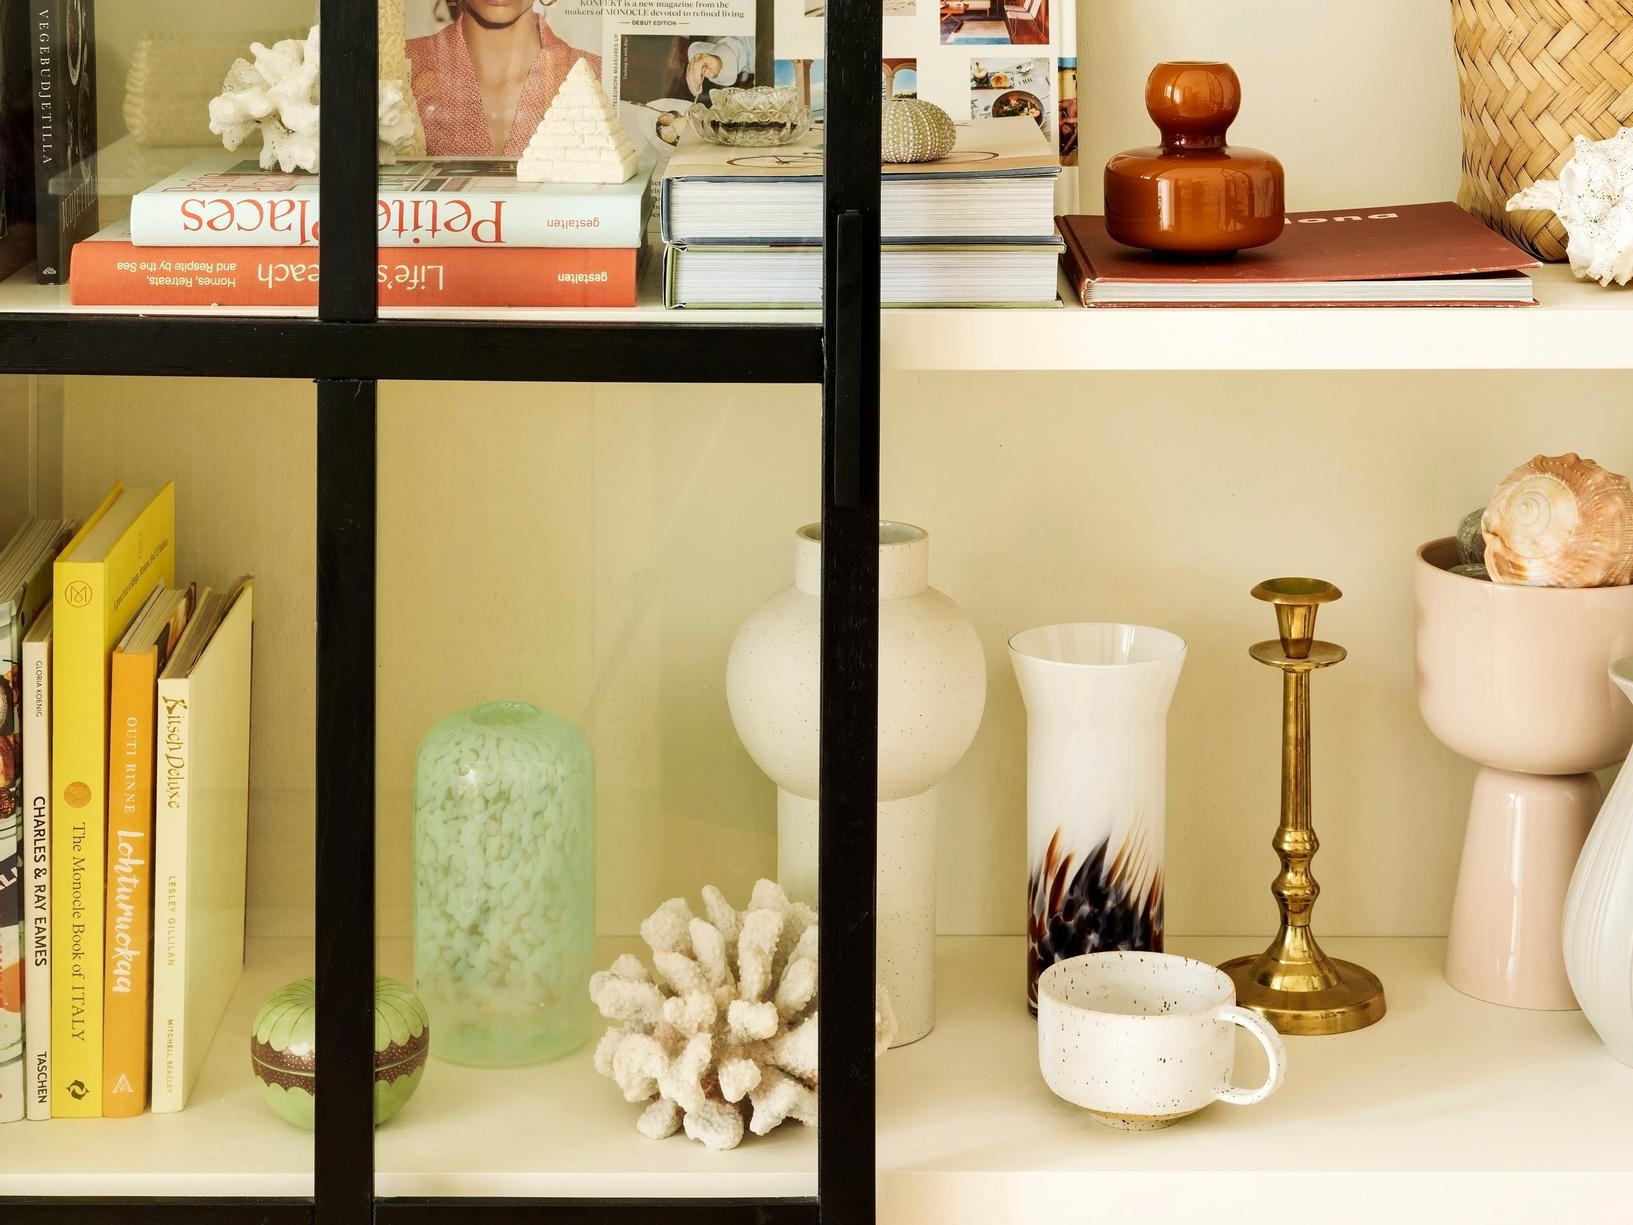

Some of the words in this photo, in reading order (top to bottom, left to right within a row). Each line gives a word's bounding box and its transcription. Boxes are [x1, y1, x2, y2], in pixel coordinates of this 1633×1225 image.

[564, 7, 595, 16] makers
[595, 8, 606, 16] of
[605, 8, 649, 17] MONOCLE
[650, 8, 682, 17] devoted
[692, 9, 721, 18] refined
[721, 9, 745, 19] living
[579, 0, 623, 10] KONFEKT
[624, 0, 633, 11] is
[638, 1, 656, 11] new
[656, 1, 694, 13] magazine
[695, 0, 715, 12] from
[716, 0, 730, 12] the
[37, 9, 53, 164] VEGEBUDJETILLA
[378, 198, 508, 246] Petite
[546, 216, 600, 230] gestalten
[116, 261, 138, 273] Sea
[139, 261, 158, 273] the
[158, 262, 173, 273] by
[176, 262, 214, 274] Respite
[215, 262, 237, 274] and
[257, 262, 320, 290] each
[377, 262, 444, 292] Life's
[557, 271, 608, 285] gestalten
[34, 660, 44, 689] GLORIA
[34, 688, 43, 718] KOENIG
[125, 716, 138, 757] OUTI
[161, 695, 187, 752] Kitsch
[123, 762, 137, 815] RINNE
[164, 754, 184, 809] Deluxe
[32, 795, 47, 864] CHARLES
[72, 821, 86, 852] The
[33, 867, 48, 880] &
[71, 855, 86, 919] Monocle
[33, 884, 47, 911] RAY
[167, 875, 177, 913] LESLEY
[111, 829, 145, 995] Lohturuokaa
[34, 916, 48, 967] EAMES
[71, 923, 86, 961] Book
[167, 916, 176, 969] GILLILAN
[71, 962, 86, 980] of
[71, 985, 86, 1042] ITALY
[166, 1016, 174, 1058] MITCHELL
[36, 1051, 48, 1104] TASCHEN
[165, 1060, 174, 1093] BEAZLEY
